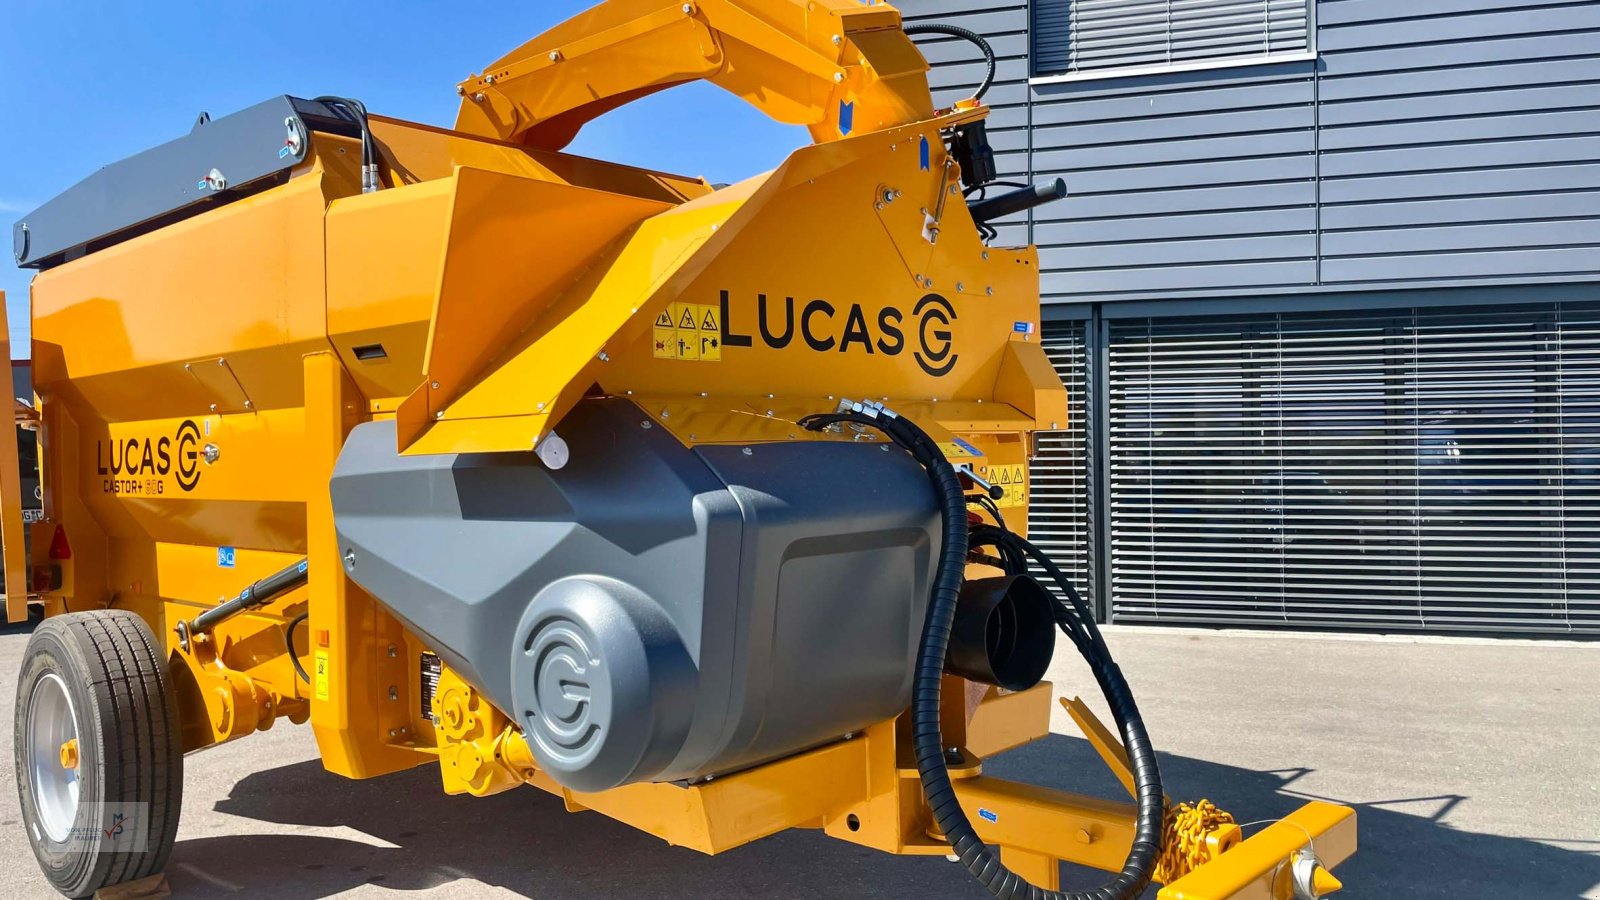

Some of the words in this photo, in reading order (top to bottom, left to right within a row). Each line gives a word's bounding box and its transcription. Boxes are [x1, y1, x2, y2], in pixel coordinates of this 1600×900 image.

[720, 290, 904, 355] LUCAS
[97, 436, 171, 475] LUCAS
[103, 479, 143, 494] CASTOR+
